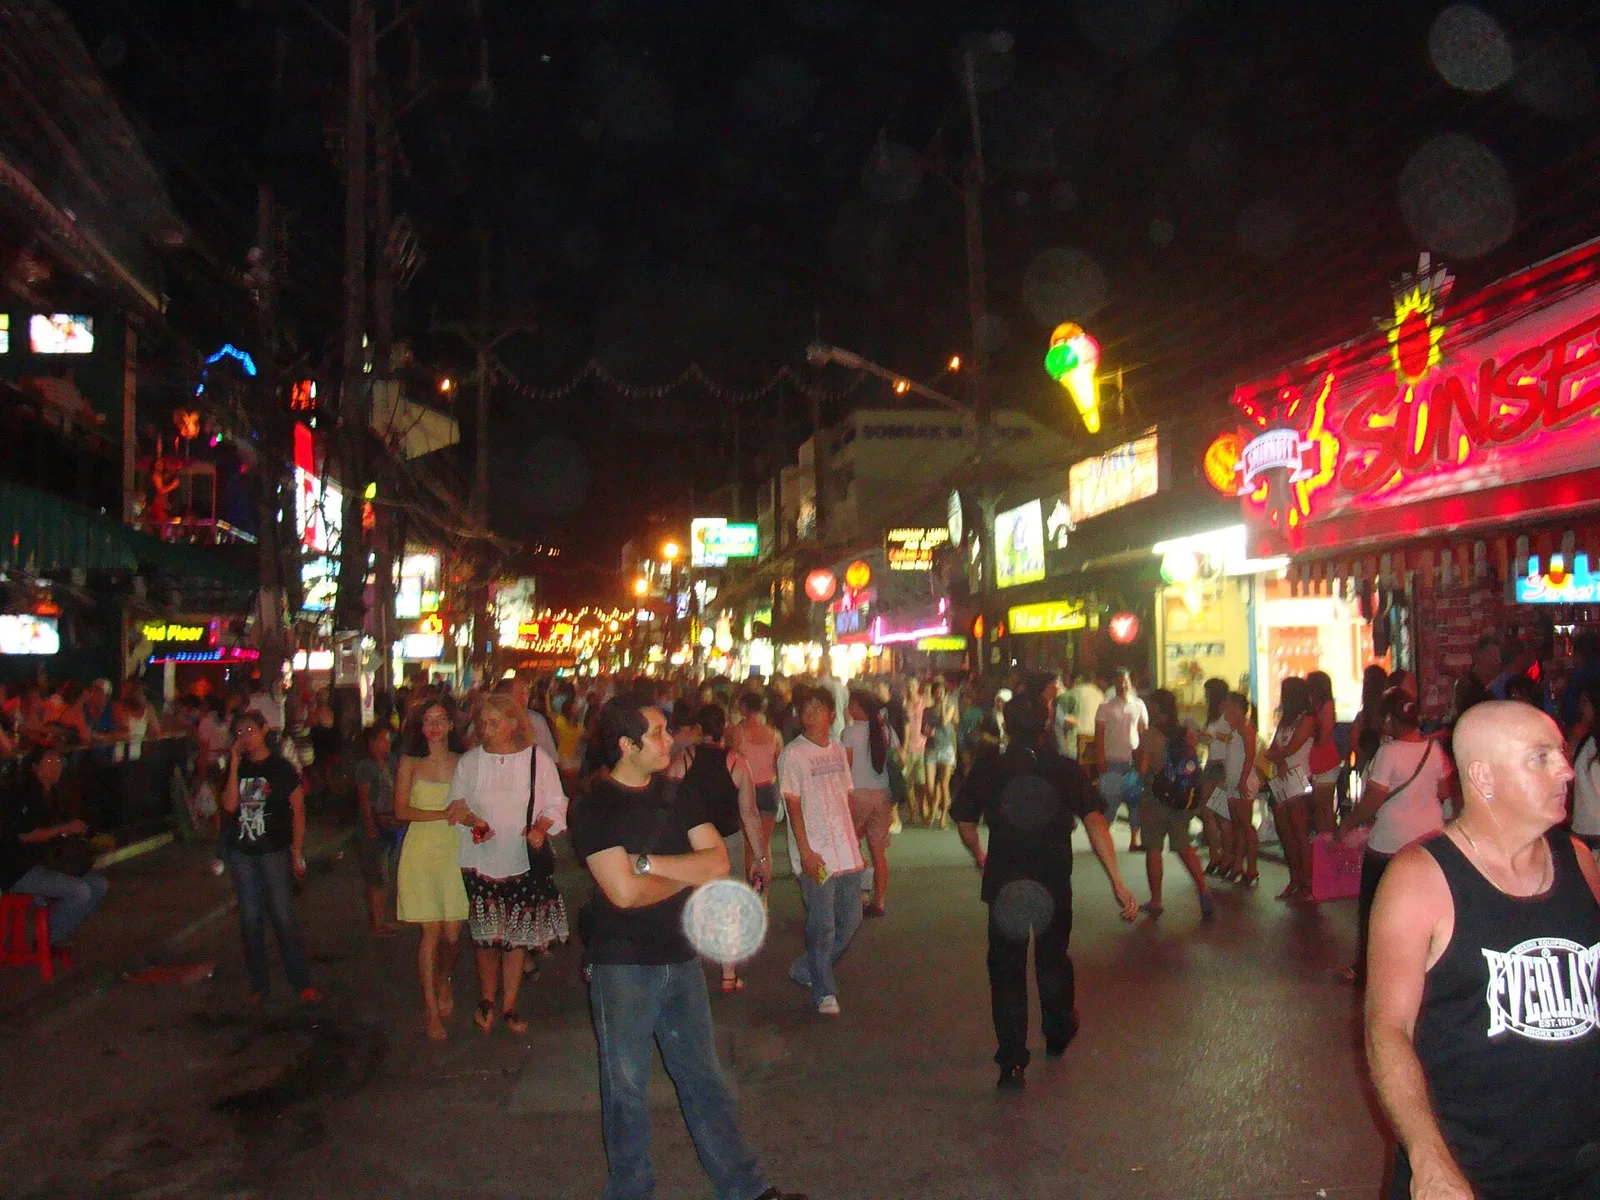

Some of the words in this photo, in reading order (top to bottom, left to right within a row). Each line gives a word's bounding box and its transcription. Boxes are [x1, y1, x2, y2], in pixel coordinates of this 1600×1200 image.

[1340, 314, 1600, 493] SUNSE
[166, 624, 204, 641] Floor
[1538, 1017, 1577, 1028] EST.1910
[1523, 1027, 1552, 1037] BRONX
